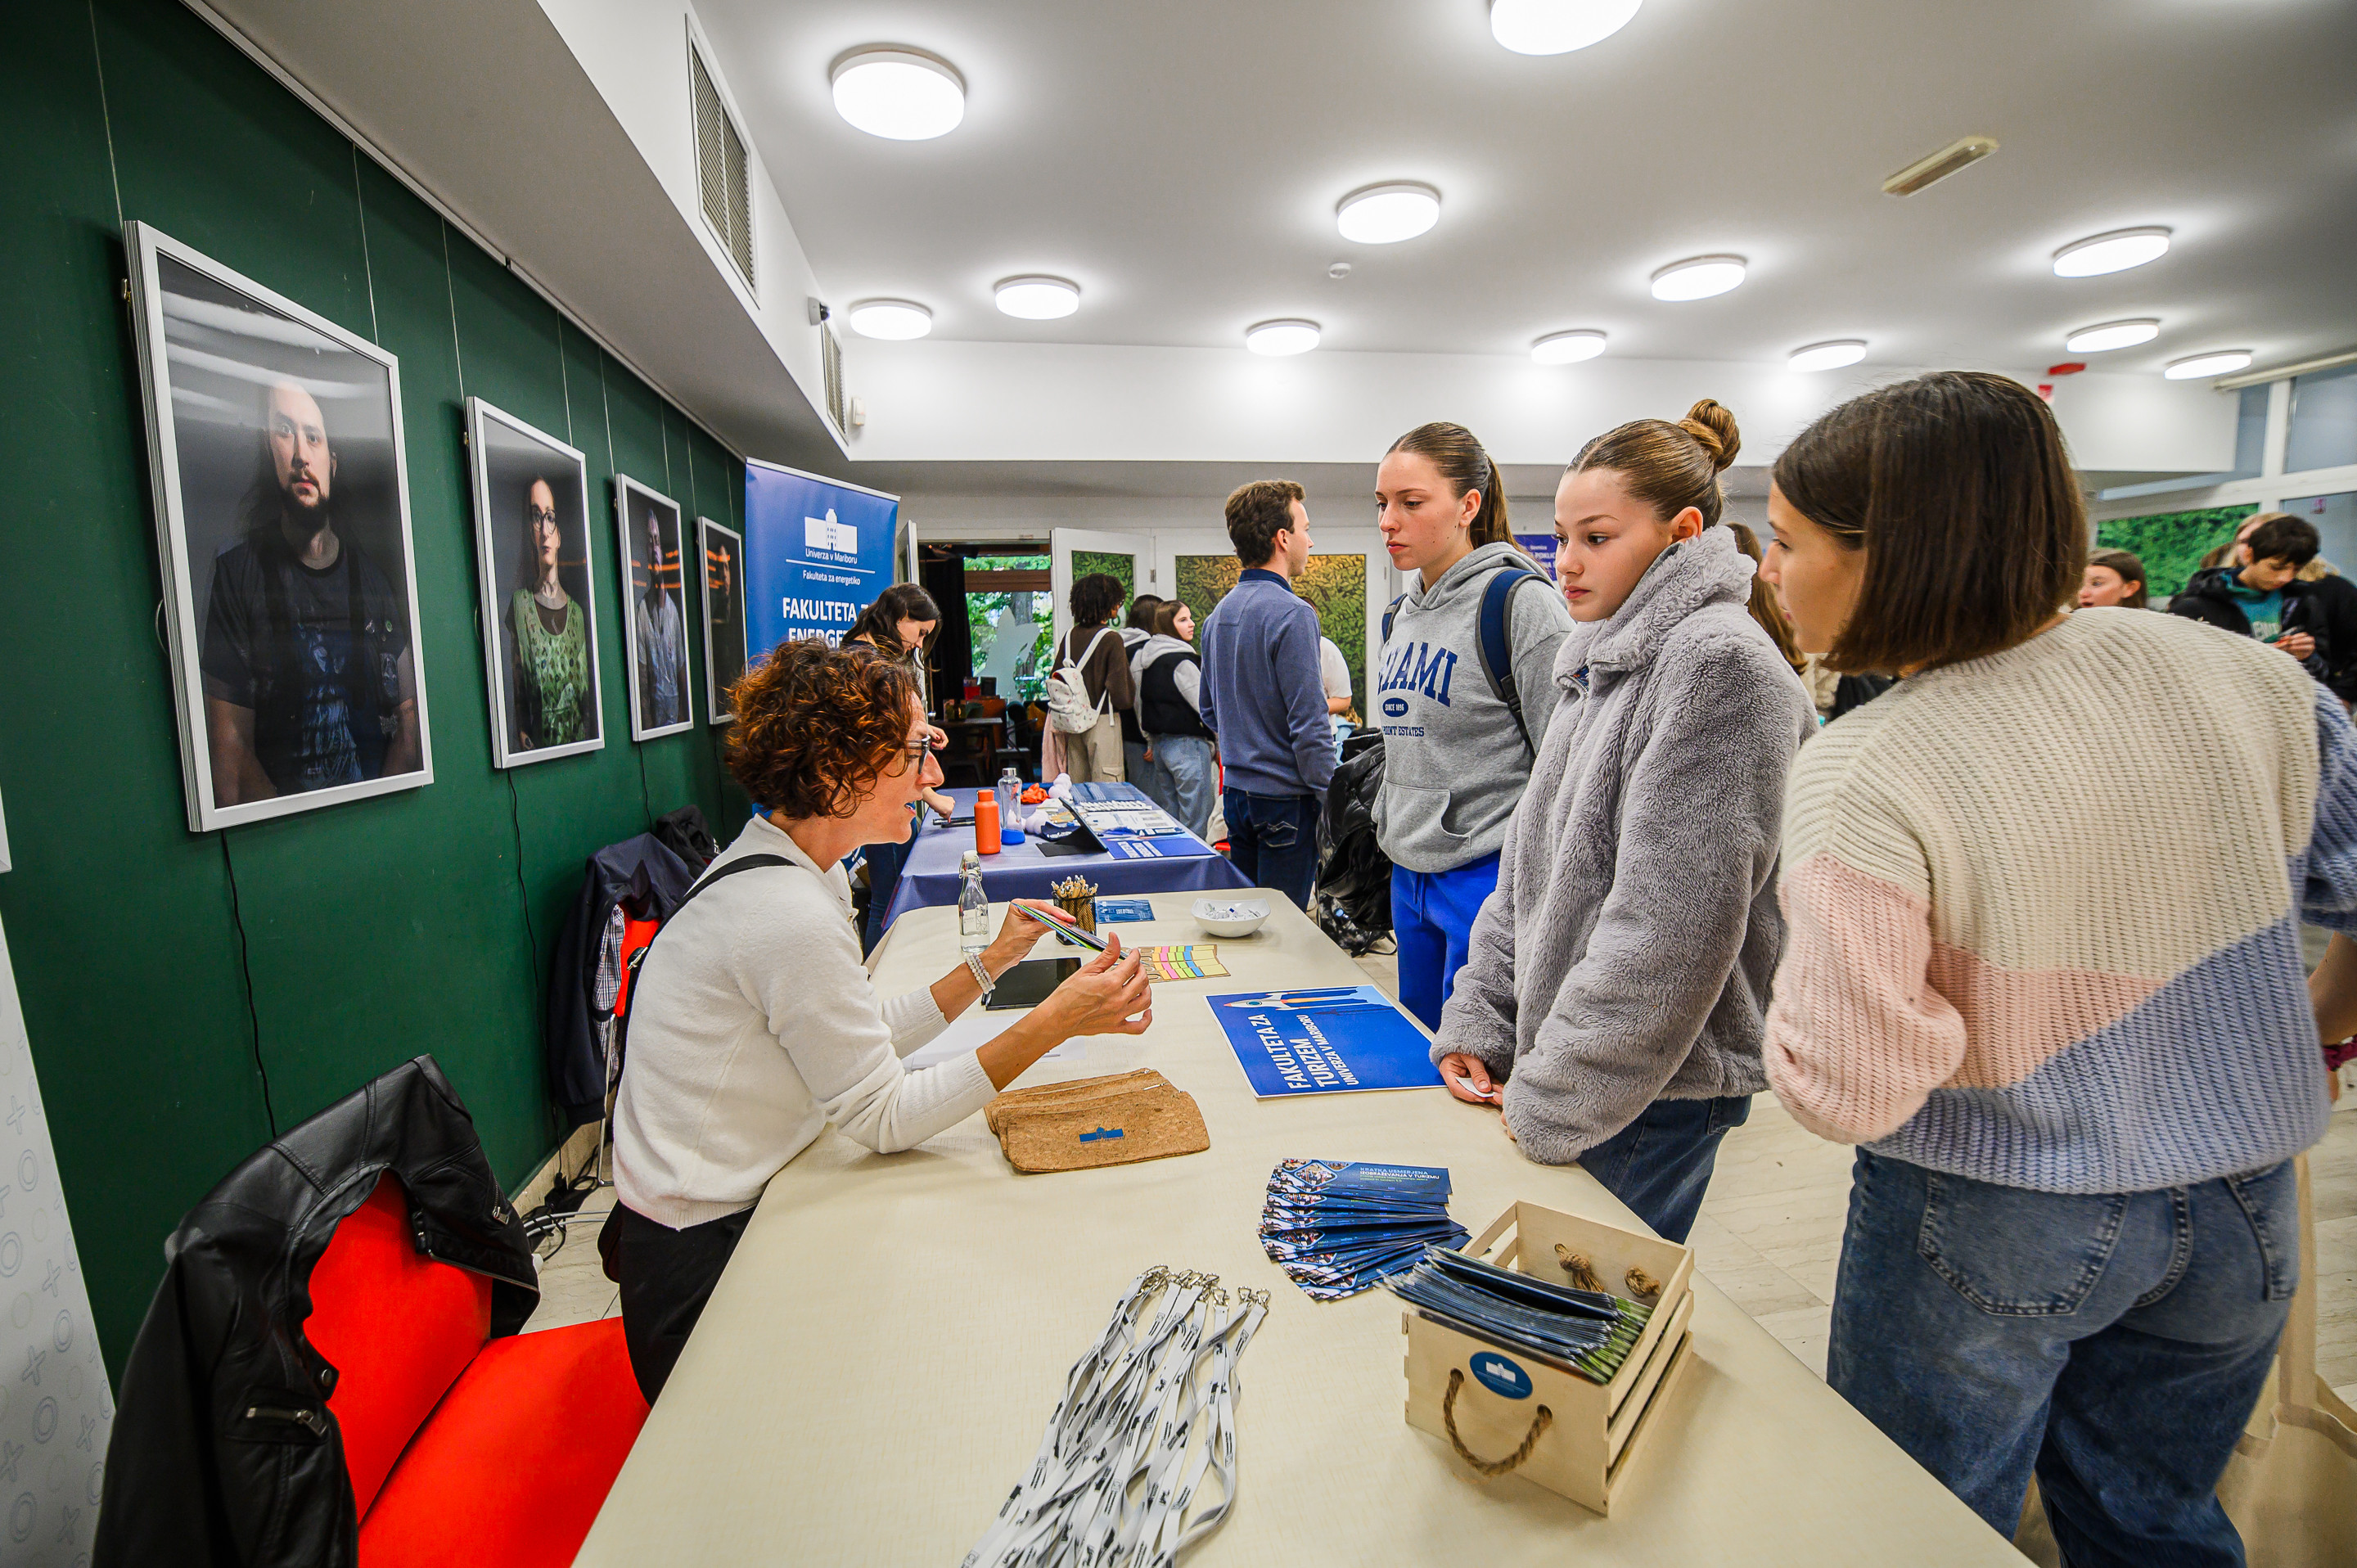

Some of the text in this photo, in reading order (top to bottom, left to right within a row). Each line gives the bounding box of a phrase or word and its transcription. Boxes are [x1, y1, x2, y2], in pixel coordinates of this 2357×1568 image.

[805, 548, 830, 561] Univerza
[835, 552, 858, 565] Mariboru
[803, 570, 827, 582] Fakulteta
[835, 574, 861, 586] energetiko
[782, 597, 858, 622] FAKULTETA
[1398, 726, 1425, 737] ESTATES
[1296, 1014, 1330, 1046] MARIBORU
[1247, 1014, 1312, 1089] FAKULTETA ZA
[1289, 1038, 1341, 1088] TURIZEM
[1323, 1051, 1359, 1085] UNIVERZA
